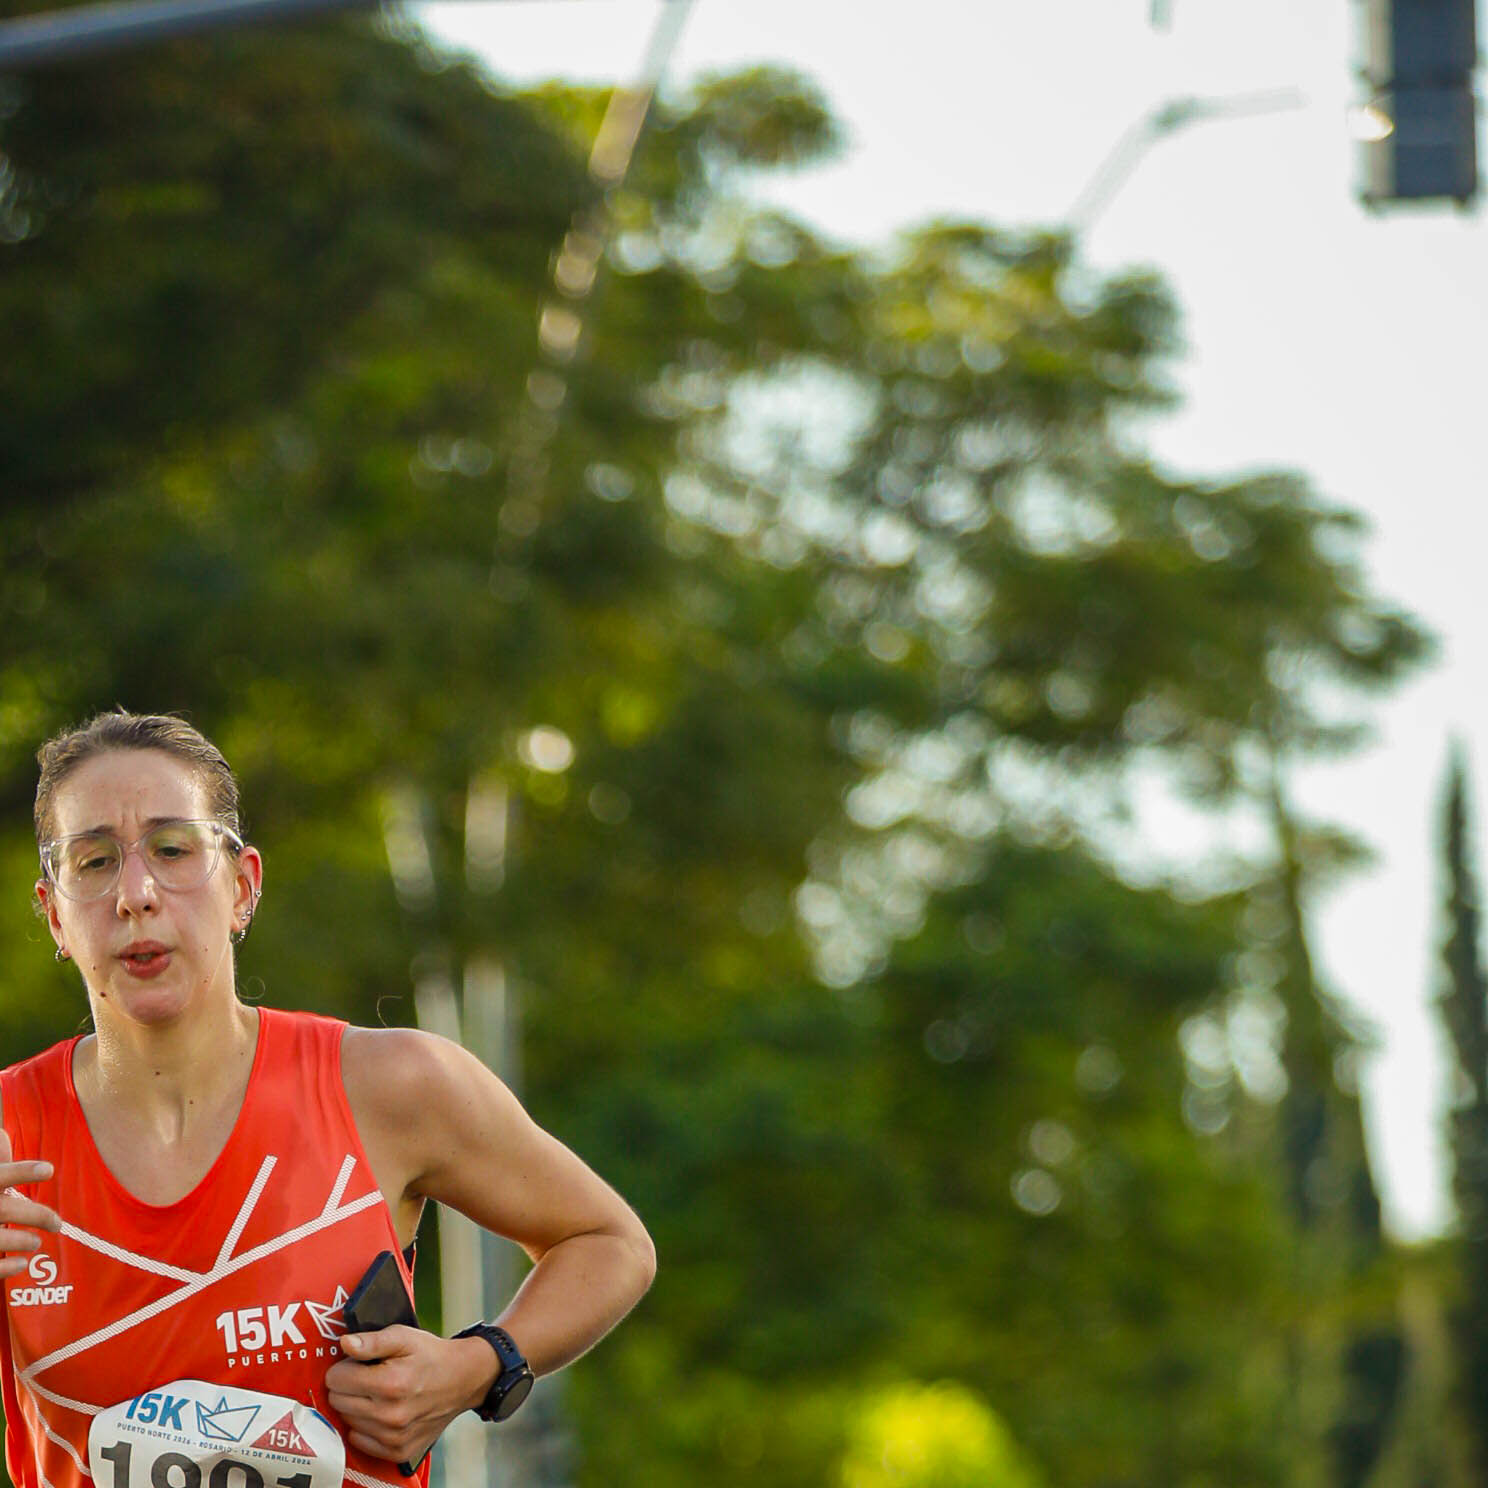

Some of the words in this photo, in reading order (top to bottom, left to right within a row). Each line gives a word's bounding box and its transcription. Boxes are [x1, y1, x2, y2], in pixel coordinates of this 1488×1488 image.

[215, 1302, 307, 1354] 15K
[125, 1392, 190, 1431] 15K
[117, 1422, 146, 1434] PUERTO
[147, 1427, 171, 1441] NORTE
[198, 1441, 232, 1453] ROSARIO
[252, 1450, 263, 1458] DE
[265, 1453, 289, 1463] ABRIL
[268, 1428, 303, 1450] 15K
